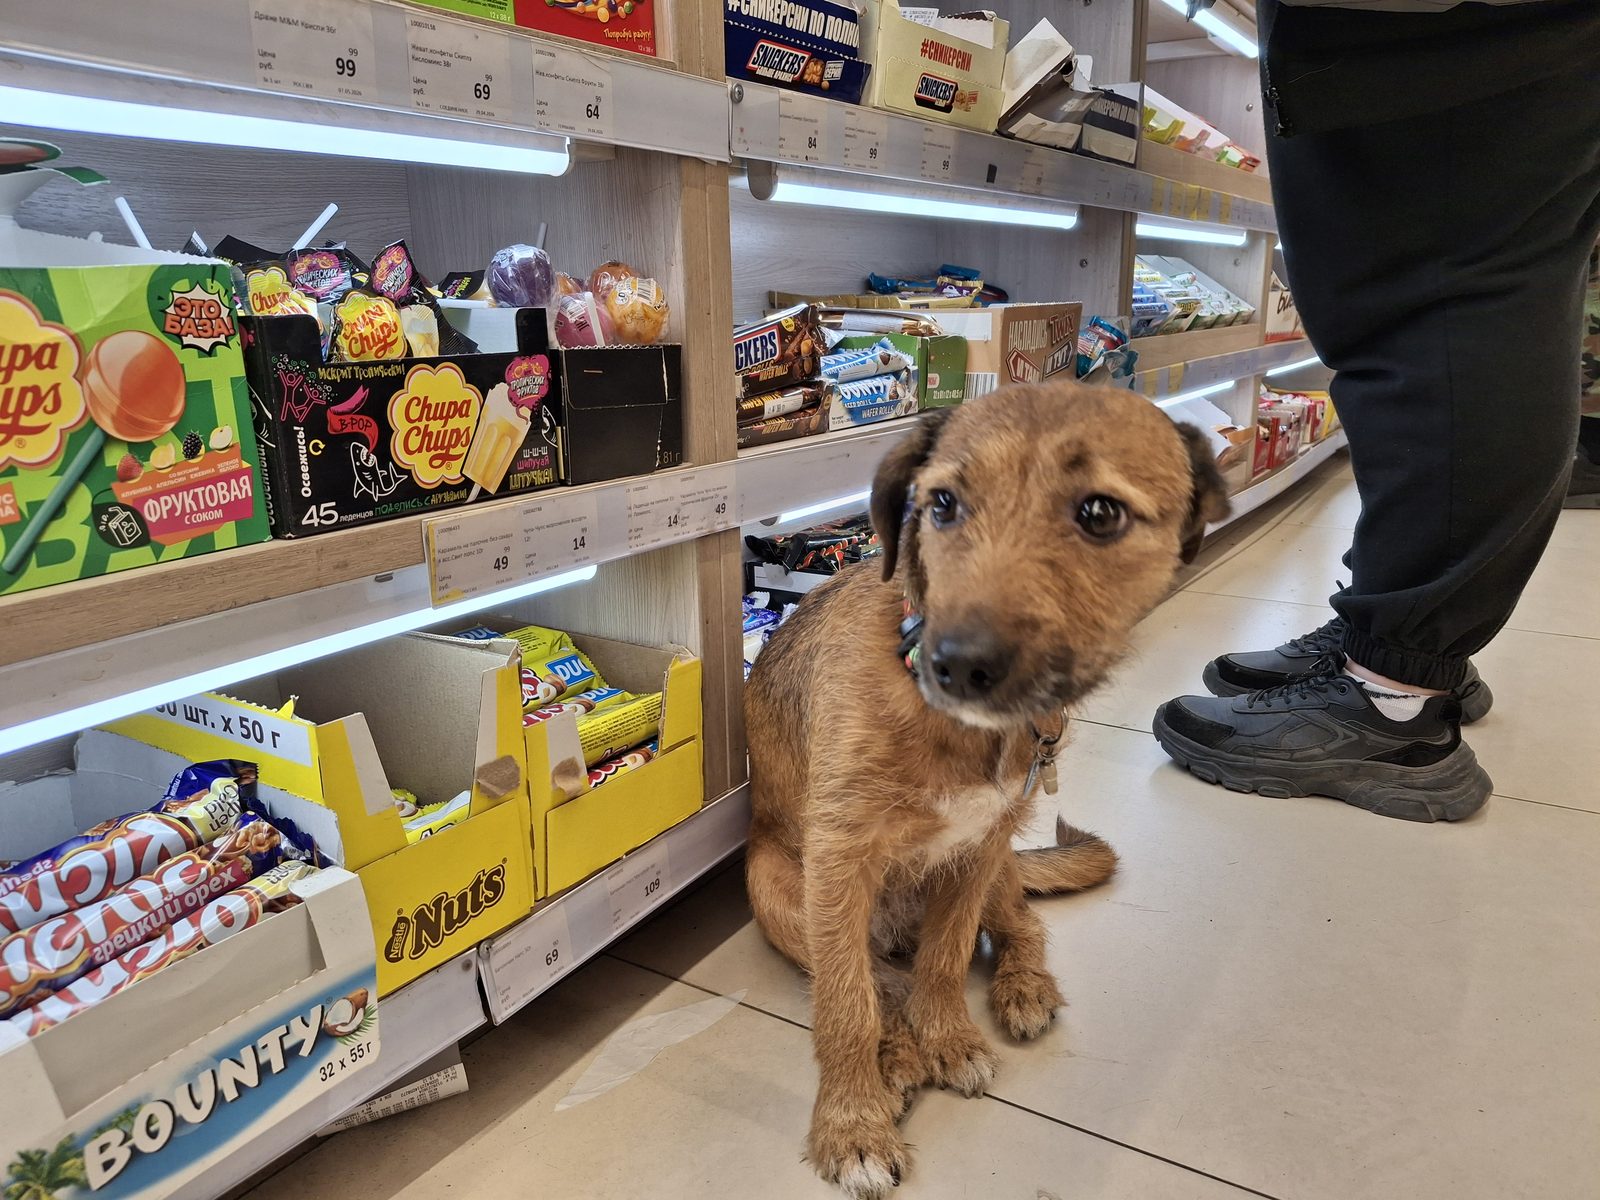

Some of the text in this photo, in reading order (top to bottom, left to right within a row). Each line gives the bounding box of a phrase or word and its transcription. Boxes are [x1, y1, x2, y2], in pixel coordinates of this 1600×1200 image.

[257, 48, 276, 60] Цена
[348, 47, 358, 57] 99
[751, 44, 807, 75] SNICKERS
[259, 62, 274, 71] руб.
[335, 57, 356, 77] 99
[412, 76, 428, 86] Цена
[484, 74, 493, 82] 99
[474, 82, 491, 100] 69
[918, 77, 954, 102] SNICKERS
[536, 99, 549, 107] Цена
[595, 95, 602, 103] 99
[586, 104, 600, 119] 64
[808, 136, 817, 149] 84
[869, 147, 878, 160] 99
[942, 160, 950, 171] 99
[174, 297, 221, 318] ЭТО
[164, 313, 236, 339] БАЗА!
[348, 321, 399, 359] Chups
[404, 395, 472, 434] Chupa
[862, 407, 879, 419] WAFER
[339, 417, 373, 431] B-POP
[402, 422, 472, 469] Chups
[663, 451, 673, 464] 81
[143, 475, 252, 523] ФРУКТОВАЯ
[192, 508, 224, 523] СОКОМ
[302, 501, 339, 527] 45
[340, 510, 374, 523] леденцов
[715, 502, 726, 515] 49
[667, 514, 678, 528] 14
[503, 545, 511, 553] 99
[573, 535, 586, 551] 14
[493, 555, 509, 571] 49
[239, 715, 265, 745] 50
[271, 731, 281, 750] г
[644, 878, 660, 897] 109
[93, 895, 183, 963] грецкий
[183, 866, 238, 910] орех
[411, 865, 504, 957] Nuts
[545, 949, 559, 967] 69
[319, 1060, 336, 1083] 32
[349, 1043, 367, 1066] 55
[82, 1004, 326, 1191] BOUNTY
